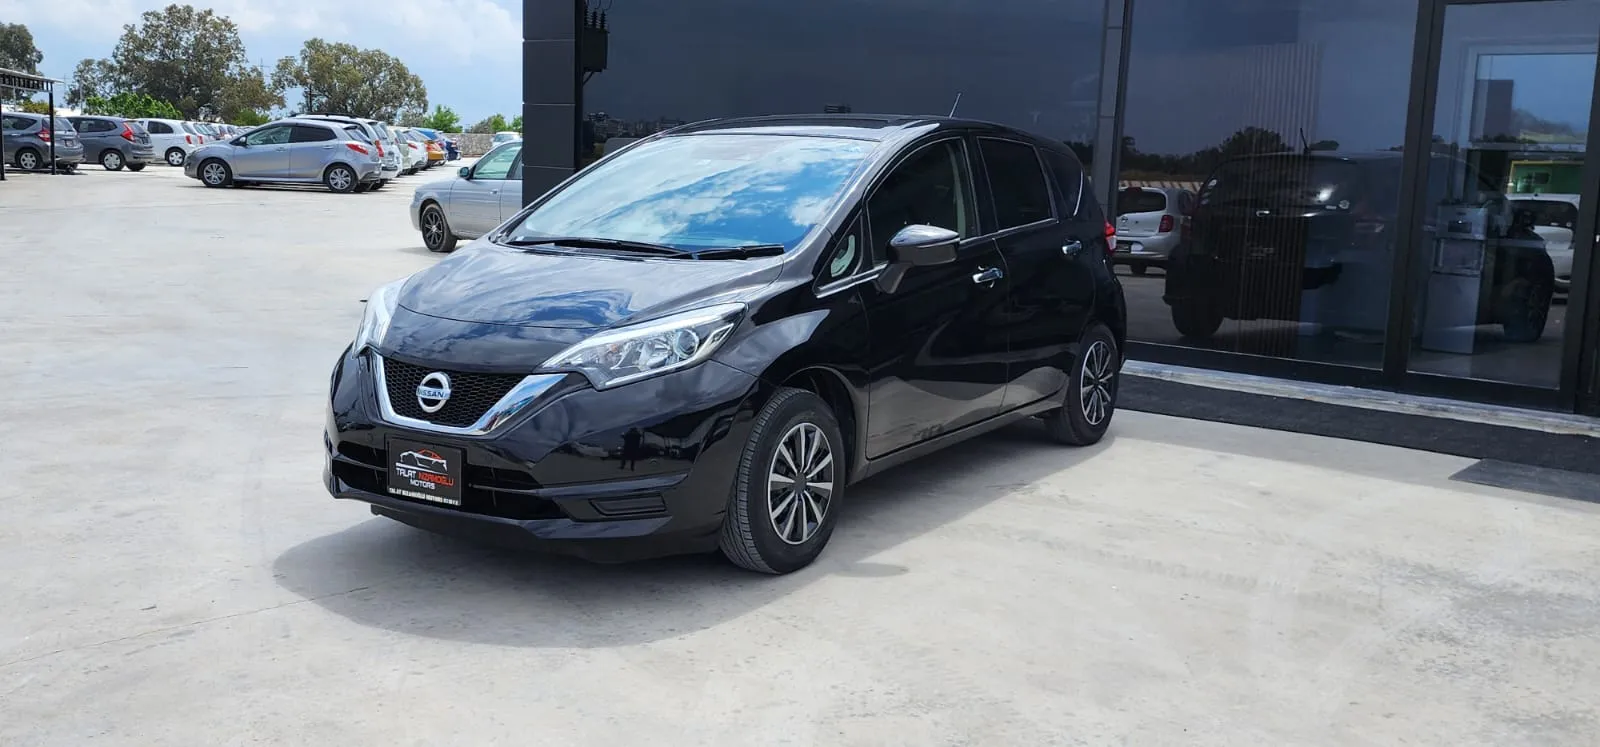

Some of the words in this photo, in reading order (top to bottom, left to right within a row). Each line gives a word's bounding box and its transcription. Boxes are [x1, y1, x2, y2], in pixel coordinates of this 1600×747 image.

[417, 388, 444, 398] NISSAN
[396, 467, 417, 479] TALAT
[410, 478, 436, 490] MOTORS
